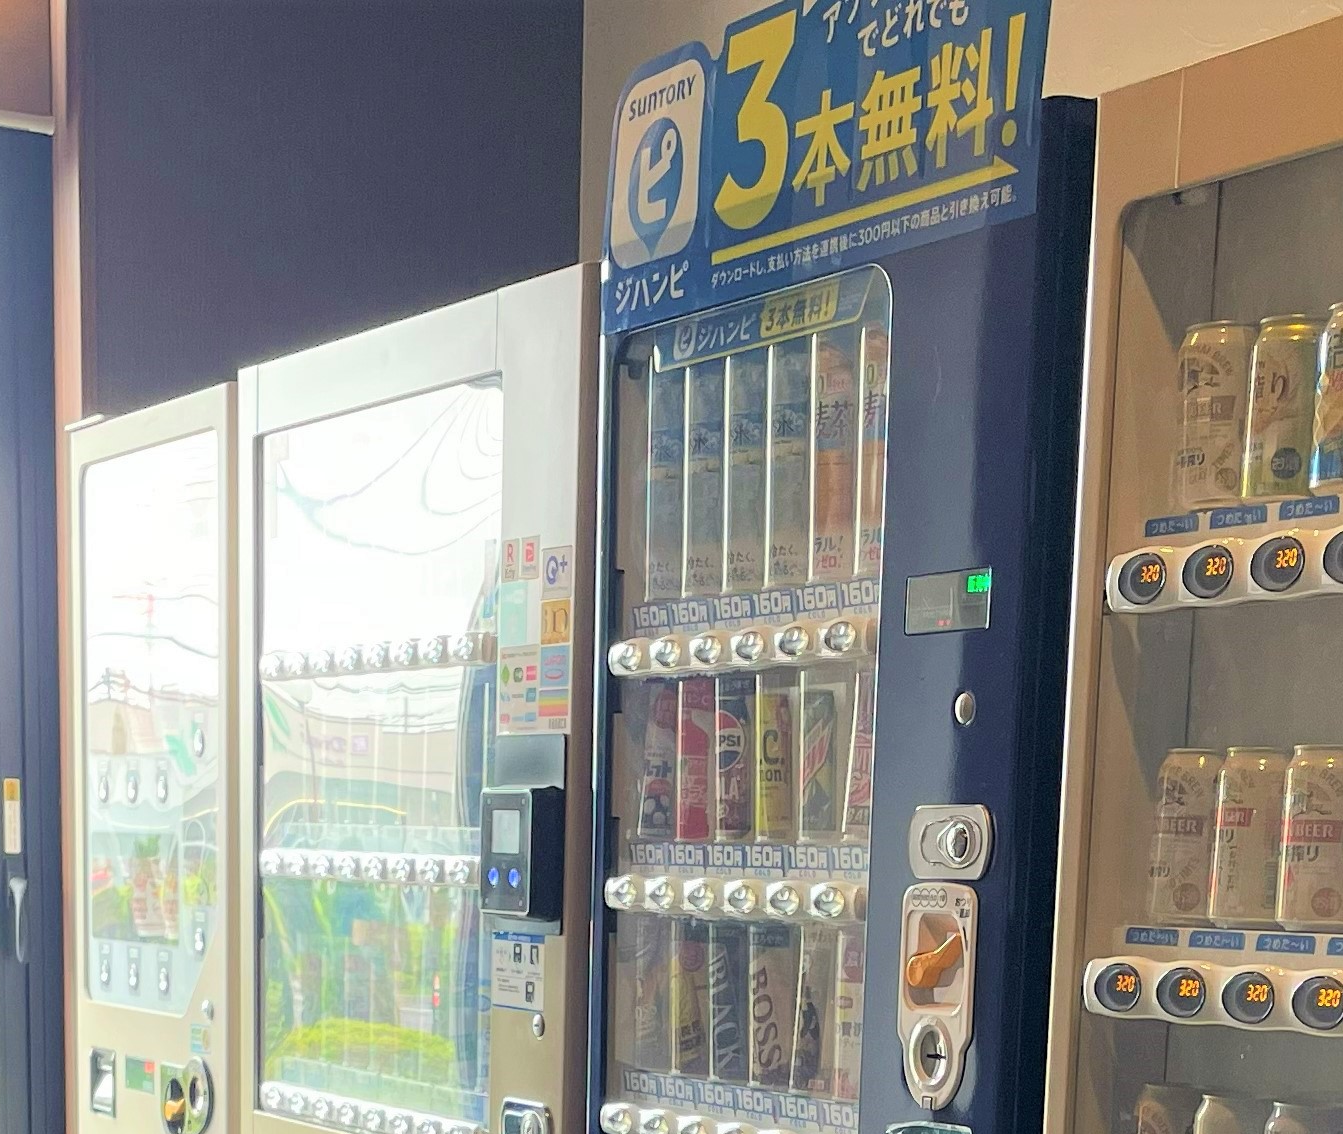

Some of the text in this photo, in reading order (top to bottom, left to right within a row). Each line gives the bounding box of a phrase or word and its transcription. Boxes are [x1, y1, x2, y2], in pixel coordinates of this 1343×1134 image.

[628, 74, 697, 122] SUNTORY
[614, 261, 692, 315] ジハンピ
[1205, 557, 1226, 576] 320
[1275, 548, 1297, 568] 320
[1140, 565, 1159, 583] 320
[1116, 975, 1136, 993] 320
[1179, 979, 1199, 997] 320
[1247, 985, 1268, 1002] 320
[1318, 989, 1341, 1007] 320
